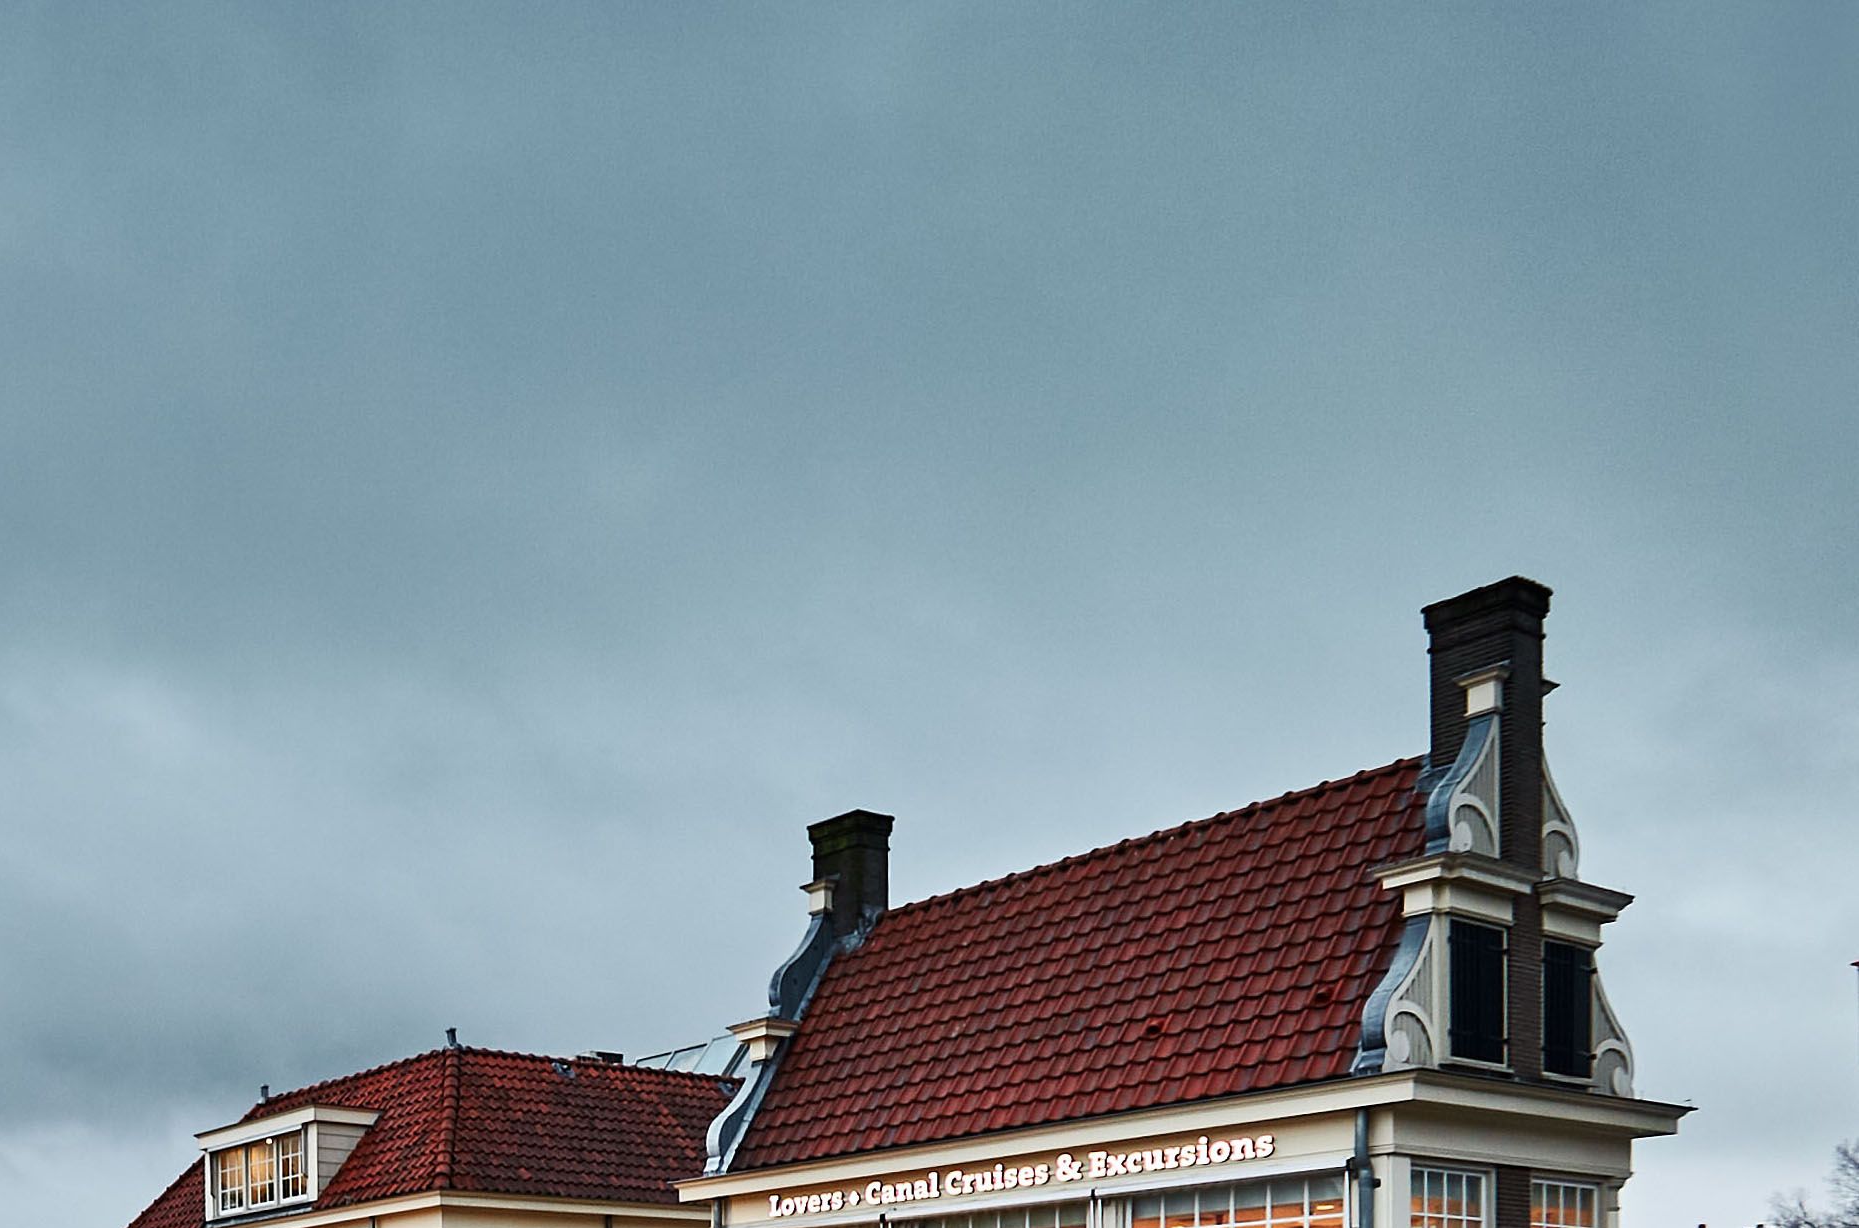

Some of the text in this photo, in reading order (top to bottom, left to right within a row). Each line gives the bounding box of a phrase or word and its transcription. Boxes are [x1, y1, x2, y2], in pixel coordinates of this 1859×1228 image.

[768, 1133, 1276, 1218] Lovers Canal Cruises & Excursions
